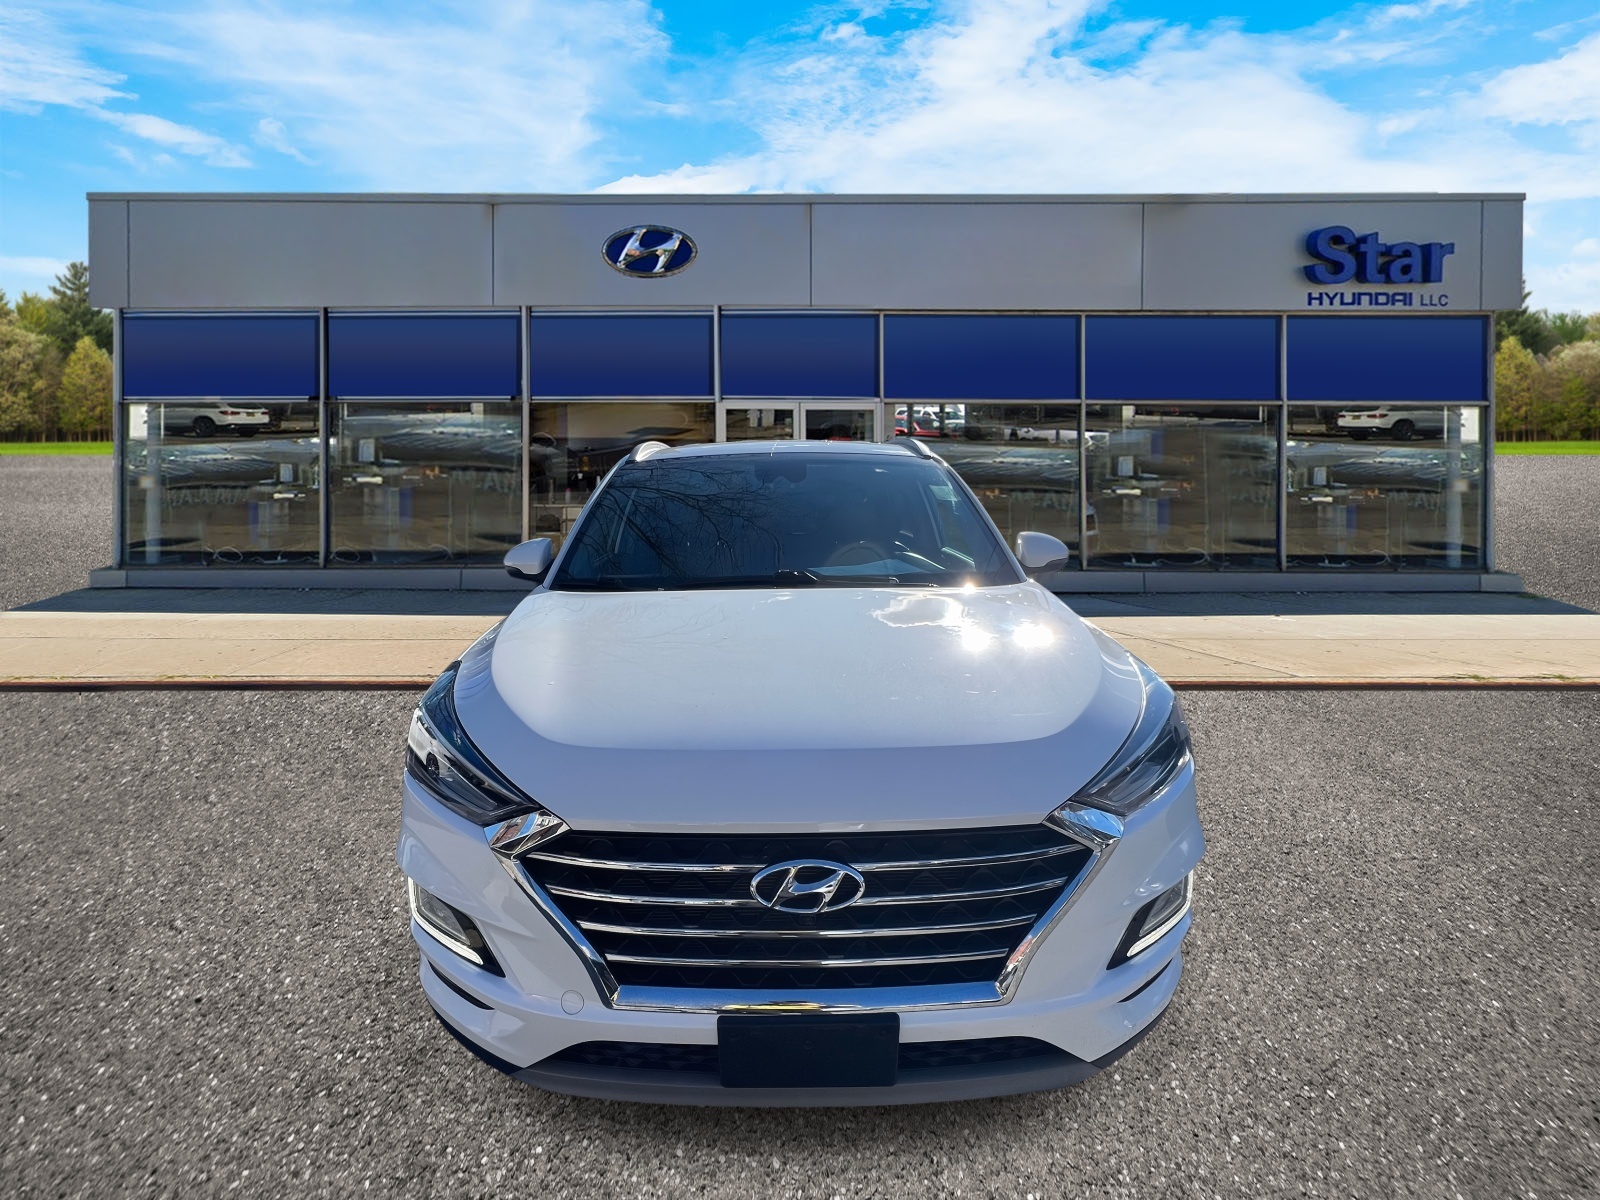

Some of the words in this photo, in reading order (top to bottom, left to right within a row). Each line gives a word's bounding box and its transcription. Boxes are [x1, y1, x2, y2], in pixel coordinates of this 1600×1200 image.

[1303, 225, 1455, 285] Star
[1307, 291, 1413, 307] HYUNDAI
[1420, 293, 1449, 307] LLC
